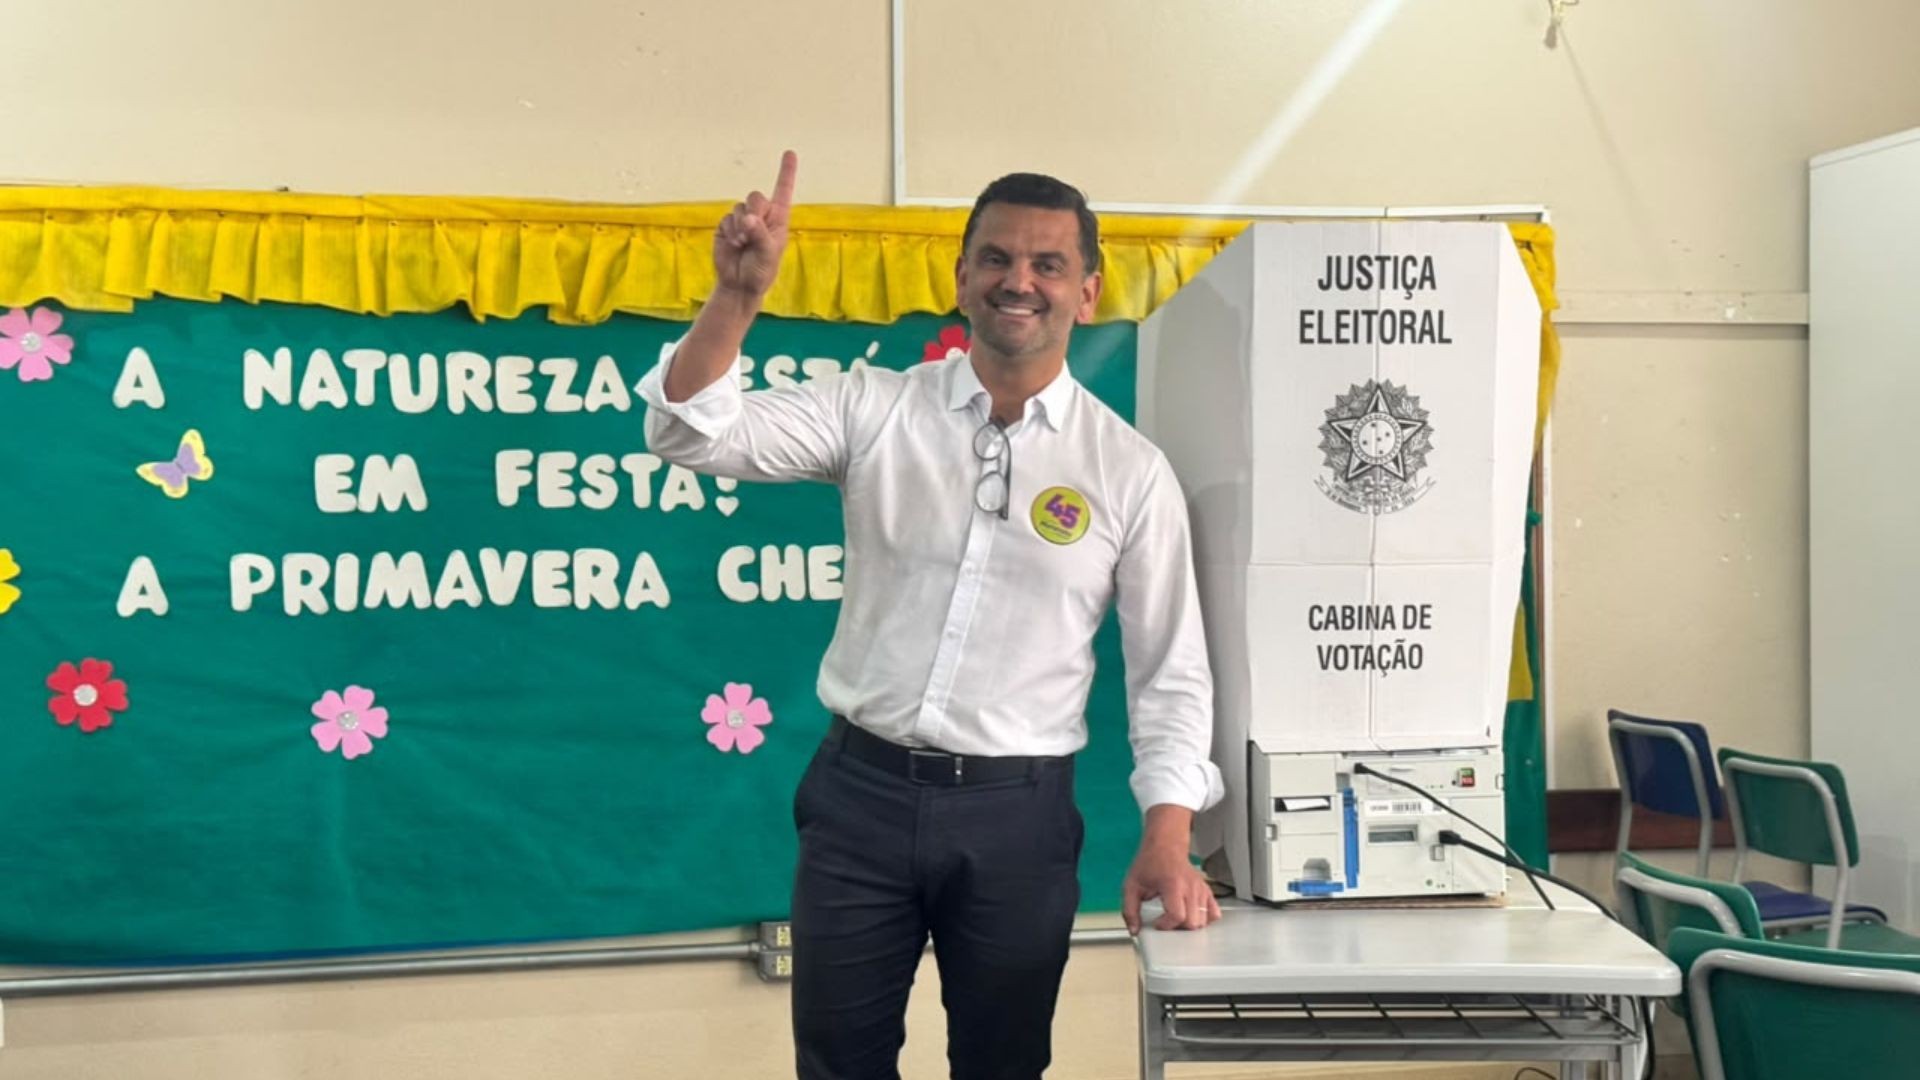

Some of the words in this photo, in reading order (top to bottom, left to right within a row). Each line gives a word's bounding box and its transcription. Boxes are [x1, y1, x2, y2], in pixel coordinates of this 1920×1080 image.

[1317, 254, 1436, 300] JUSTIÇA
[1299, 309, 1453, 345] ELEITORAL
[113, 347, 165, 409] A
[243, 347, 631, 414] NATUREZA
[314, 454, 427, 513] EM
[1044, 492, 1082, 529] 45
[117, 556, 169, 617] A
[230, 548, 670, 616] PRIMAVERA
[1308, 604, 1396, 631] CABINA
[1402, 604, 1432, 630] DE
[1317, 639, 1424, 677] VOTAÇÃO
